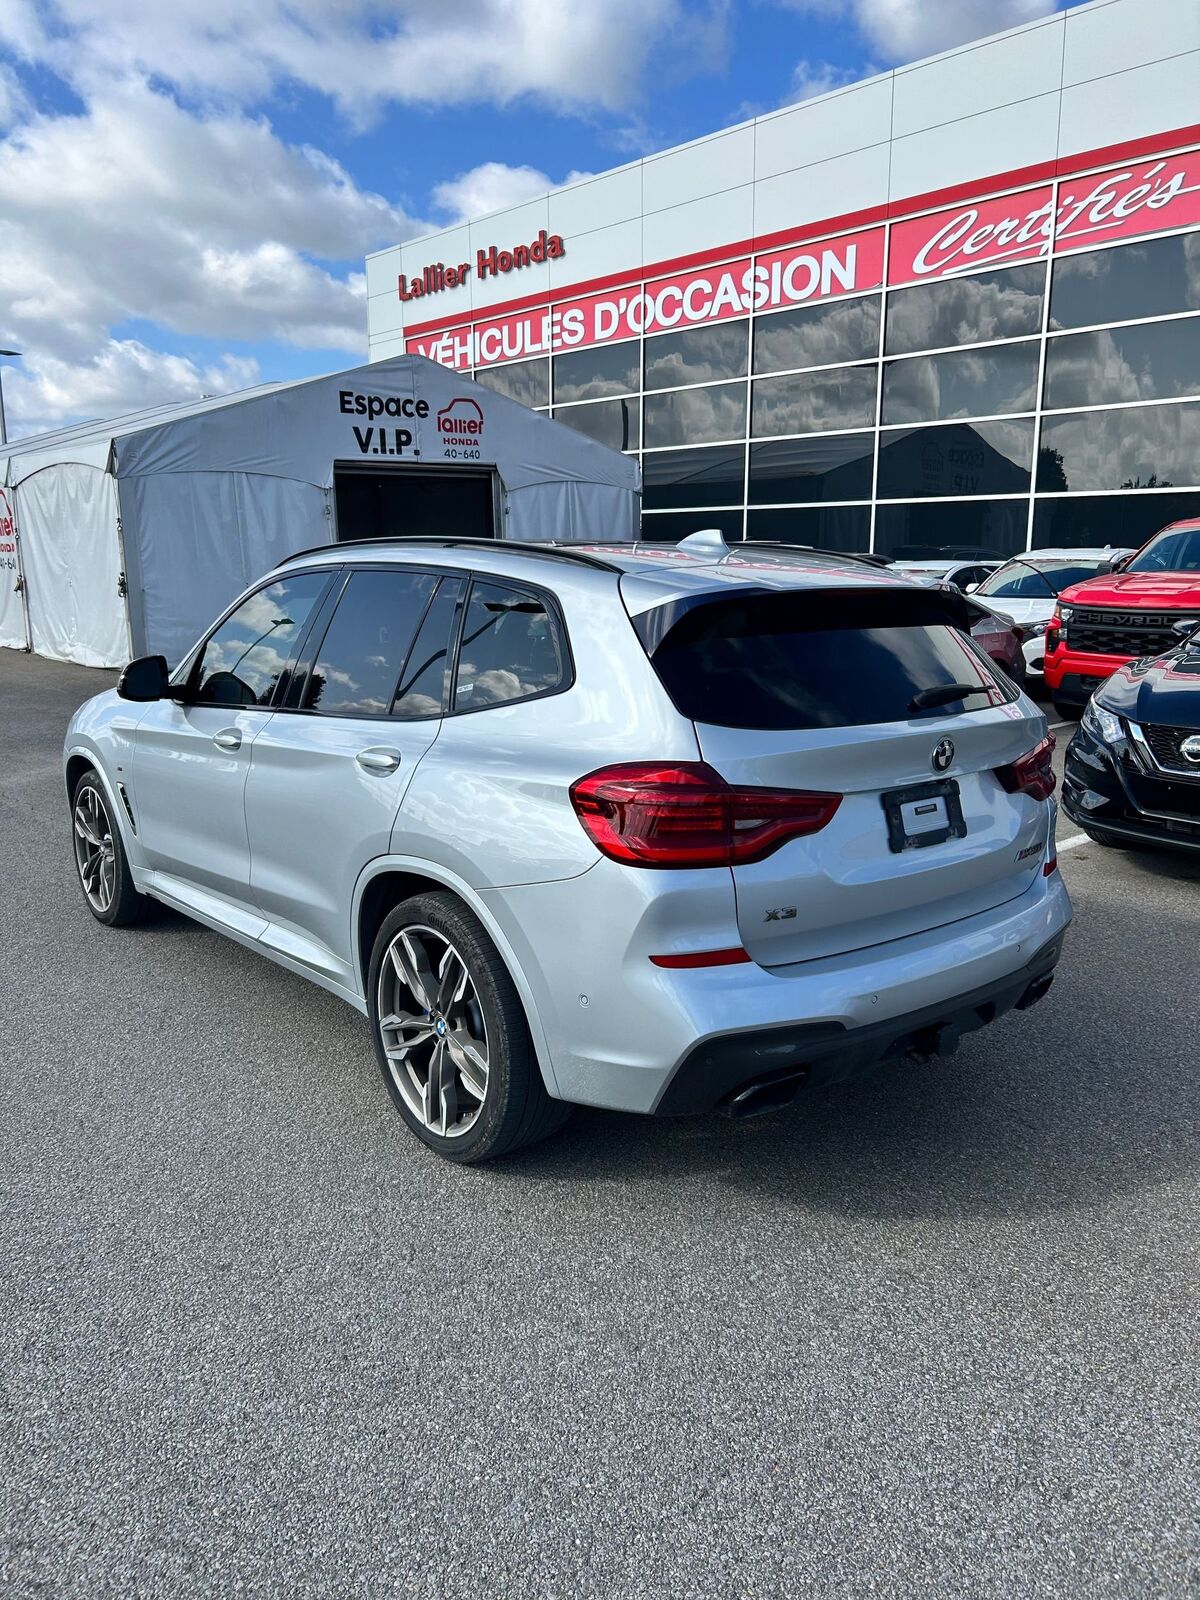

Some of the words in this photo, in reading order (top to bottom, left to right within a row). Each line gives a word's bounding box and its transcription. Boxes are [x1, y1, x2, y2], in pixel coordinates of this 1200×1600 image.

[594, 244, 857, 340] D'OCCASION
[912, 162, 1186, 274] Certifiés
[398, 262, 471, 301] Lallier
[476, 230, 565, 280] Honda
[339, 390, 430, 421] Espace
[437, 416, 484, 434] lallier
[352, 426, 420, 456] V.I.P.
[443, 437, 479, 446] HONDA
[444, 449, 480, 459] 40-640
[1075, 612, 1182, 627] CHEVROL
[763, 906, 798, 922] X3
